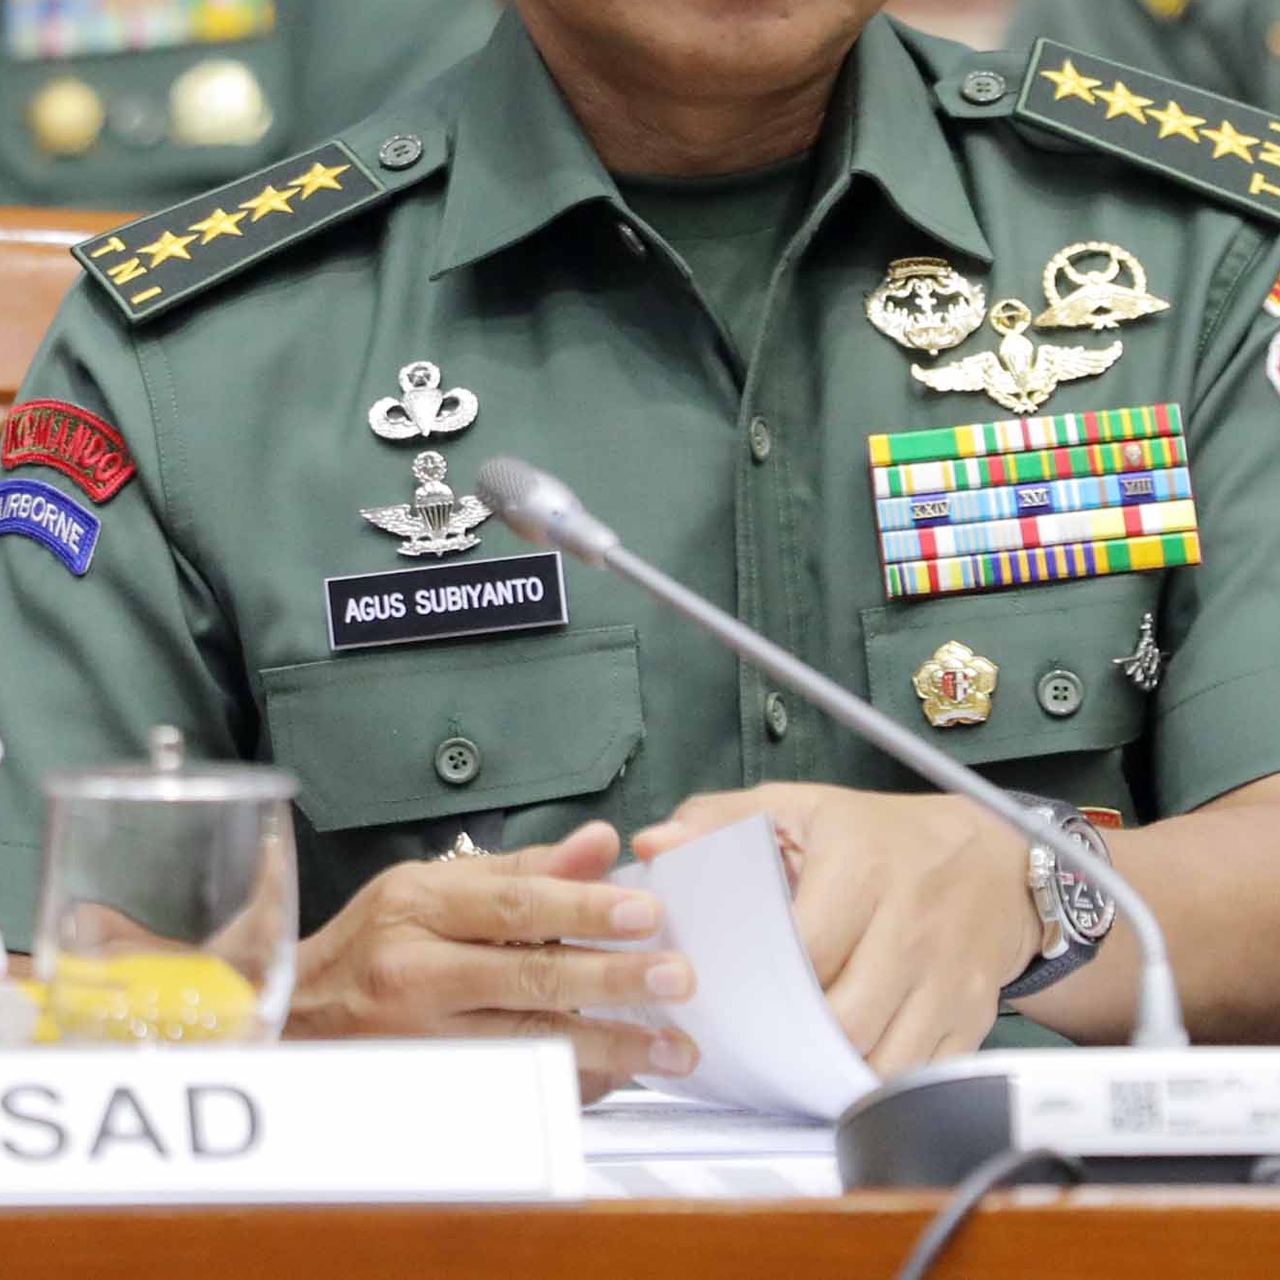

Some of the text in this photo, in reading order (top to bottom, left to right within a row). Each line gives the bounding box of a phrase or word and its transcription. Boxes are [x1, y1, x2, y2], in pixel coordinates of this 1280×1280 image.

[90, 236, 164, 305] TNI
[345, 577, 544, 624] AGUS SUBIYANTO
